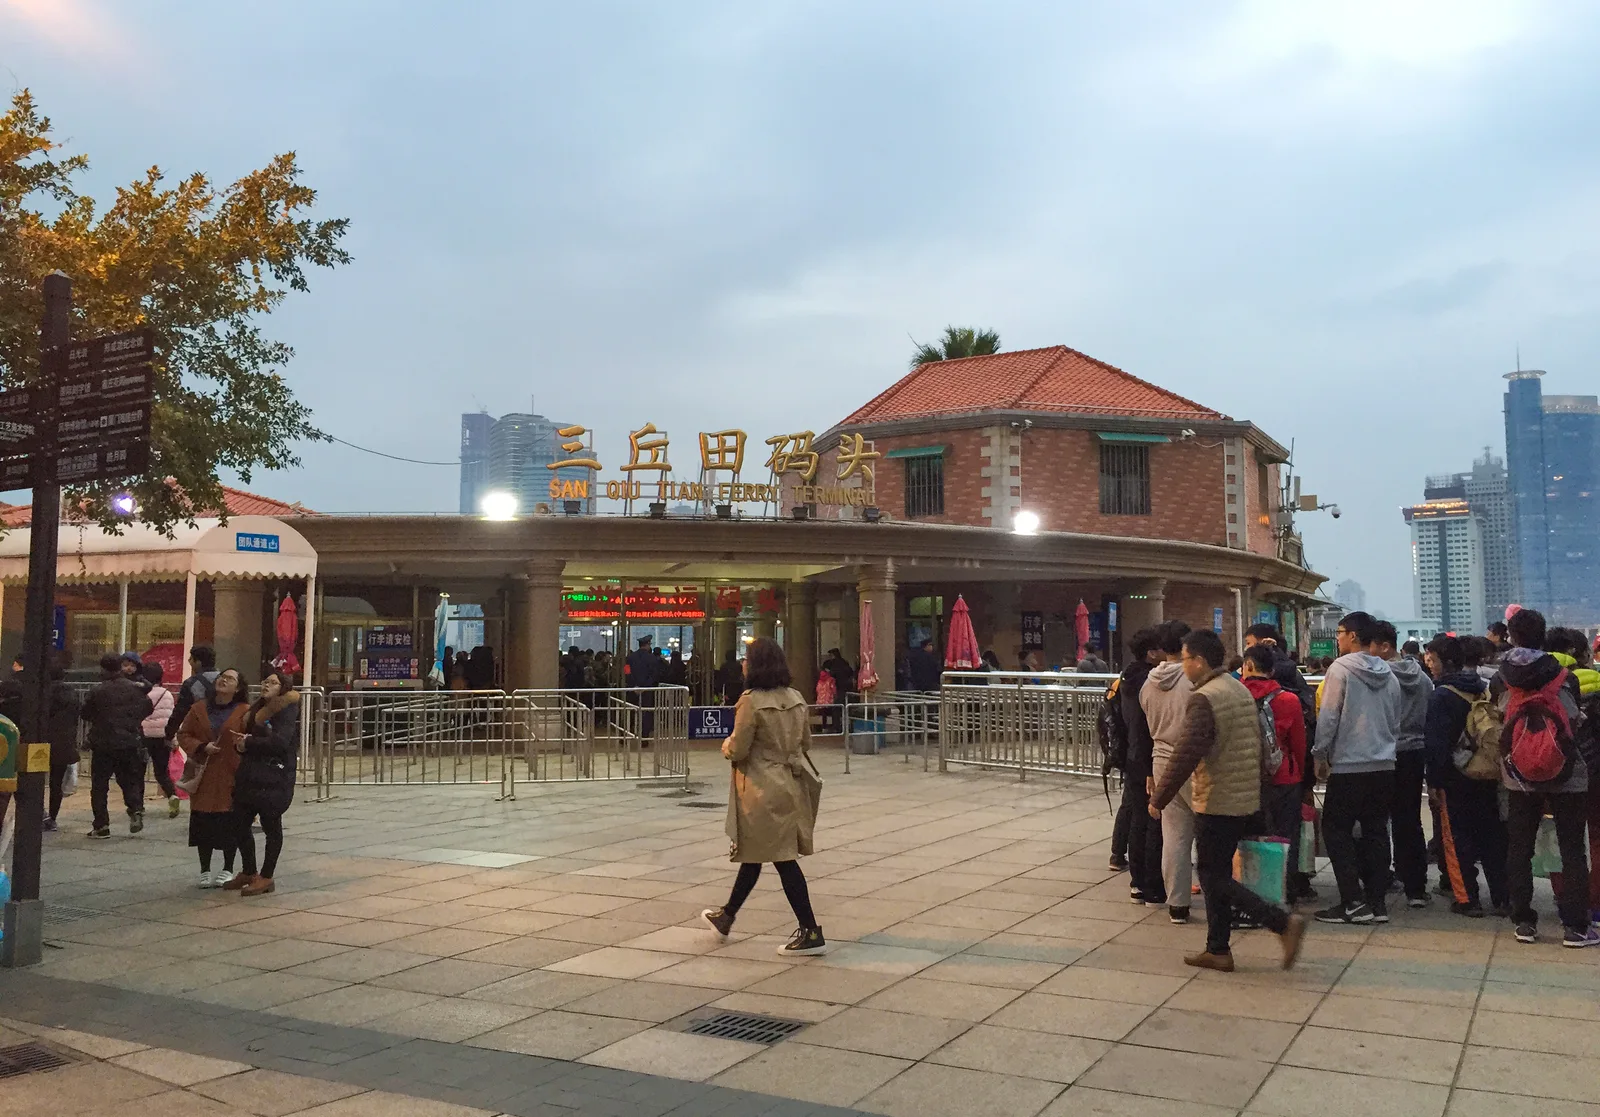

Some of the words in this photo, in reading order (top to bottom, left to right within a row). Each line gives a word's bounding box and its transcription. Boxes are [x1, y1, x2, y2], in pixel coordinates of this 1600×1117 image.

[546, 422, 881, 481] 三丘田码头
[549, 479, 588, 499] SAN
[606, 480, 641, 500] QIU
[657, 481, 703, 500] TIAN
[719, 482, 778, 503] FERRY
[791, 484, 876, 506] TERMINAL
[238, 536, 268, 548] 团队通道
[1024, 616, 1041, 628] 行李
[368, 633, 411, 646] 行李请安检
[1024, 632, 1042, 644] 安检
